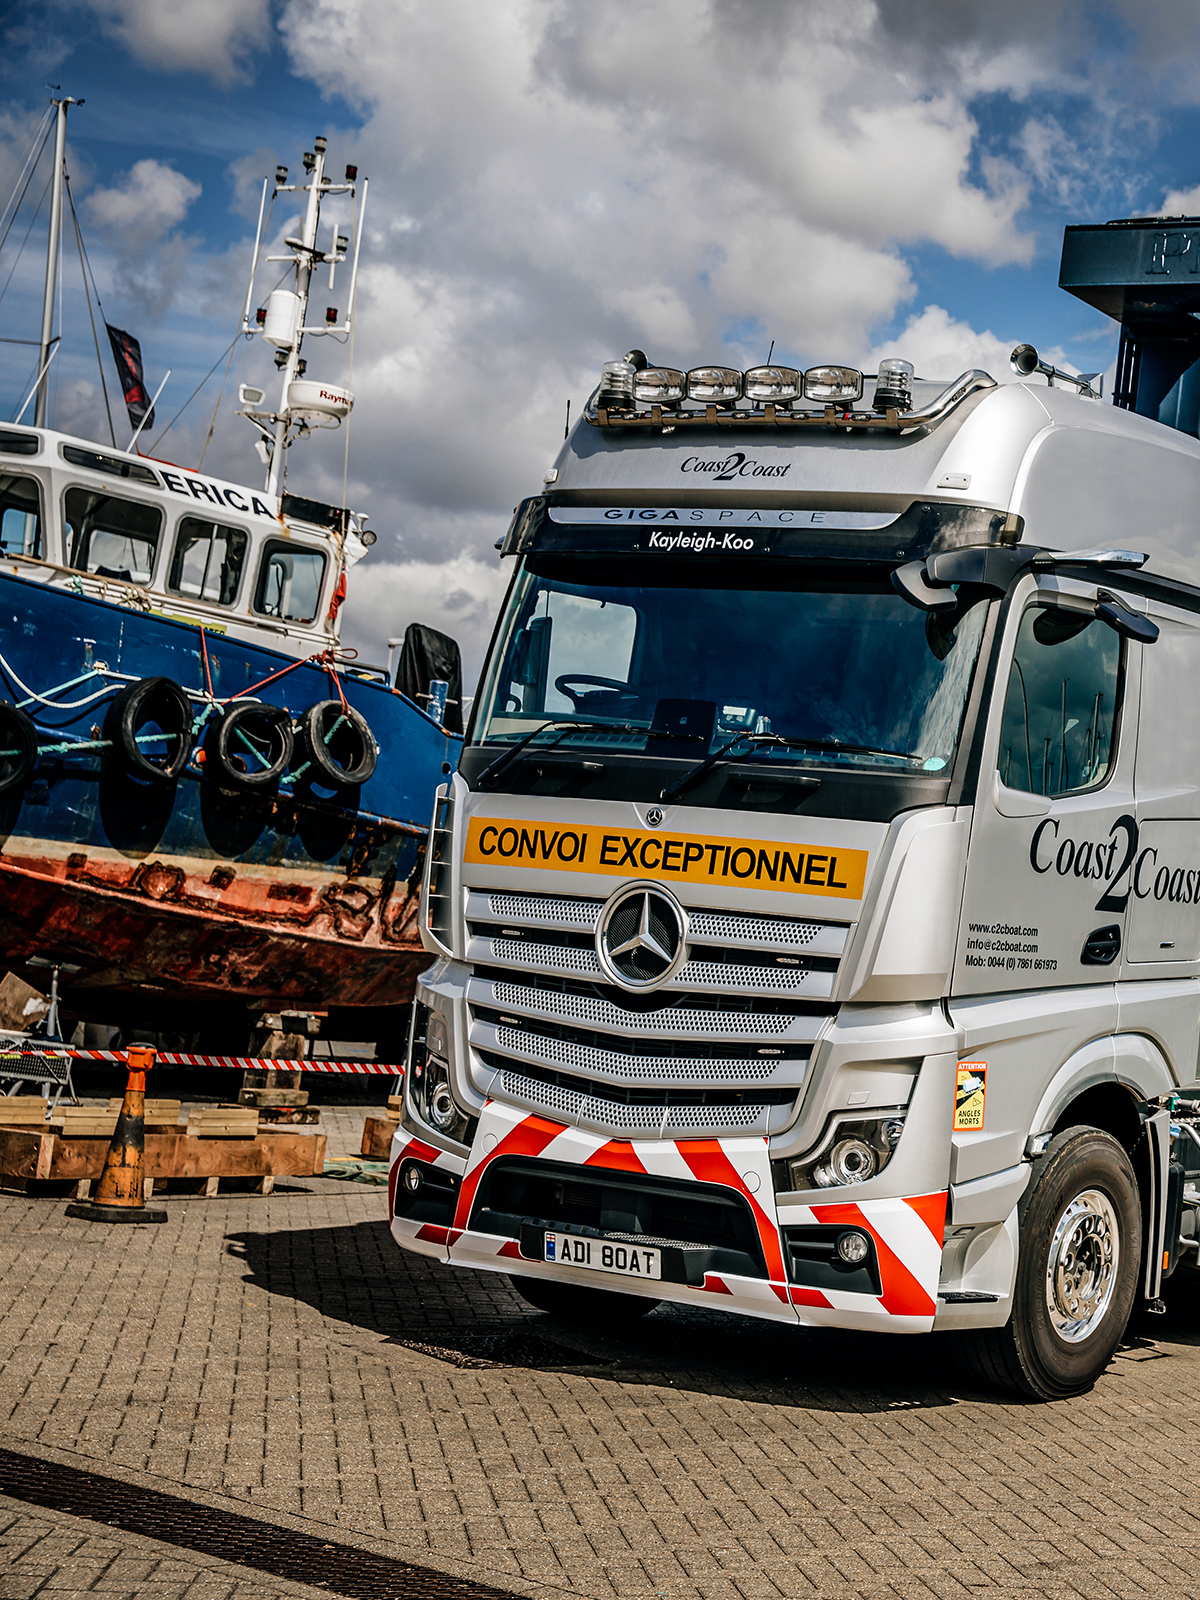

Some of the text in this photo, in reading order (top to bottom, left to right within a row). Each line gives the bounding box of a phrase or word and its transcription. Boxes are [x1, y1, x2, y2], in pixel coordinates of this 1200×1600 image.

[159, 470, 277, 521] ERICA
[648, 531, 755, 553] Kayleigh-Koo
[478, 825, 848, 889] CONVOI EXCEPTIONNEL
[968, 923, 1039, 937] www.c2cboat.com
[966, 938, 1039, 953] info@c2cboat.com
[965, 954, 986, 967] Mob:
[987, 956, 1005, 968] 0044
[1006, 957, 1016, 971] (0)
